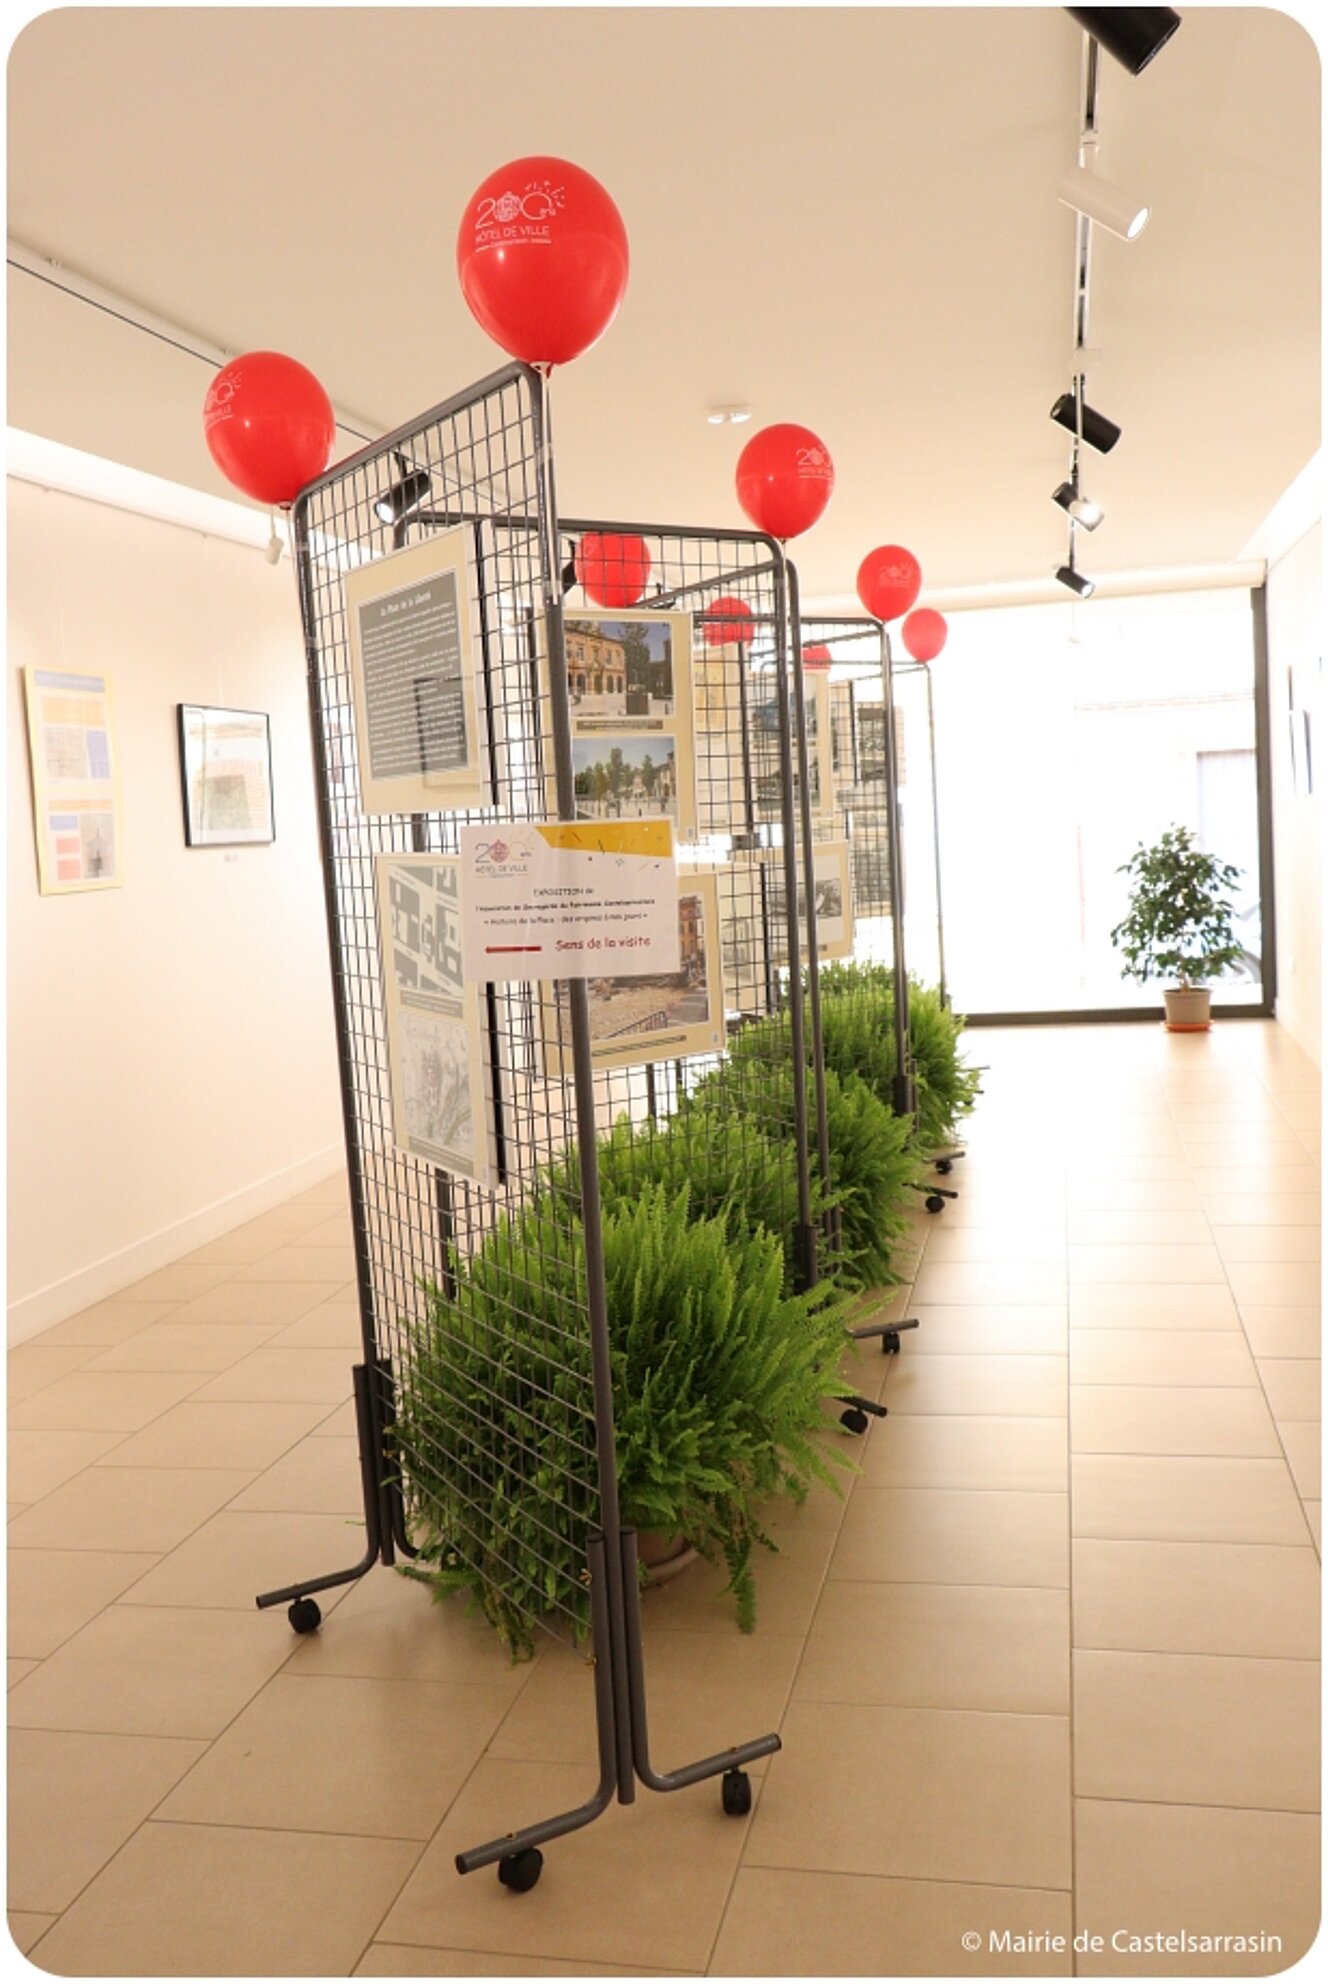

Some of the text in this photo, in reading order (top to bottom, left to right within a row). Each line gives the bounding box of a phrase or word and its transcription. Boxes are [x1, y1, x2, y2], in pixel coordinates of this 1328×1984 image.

[503, 225, 517, 238] DE
[519, 225, 550, 237] VILLE
[555, 936, 651, 951] Sens de la visite
